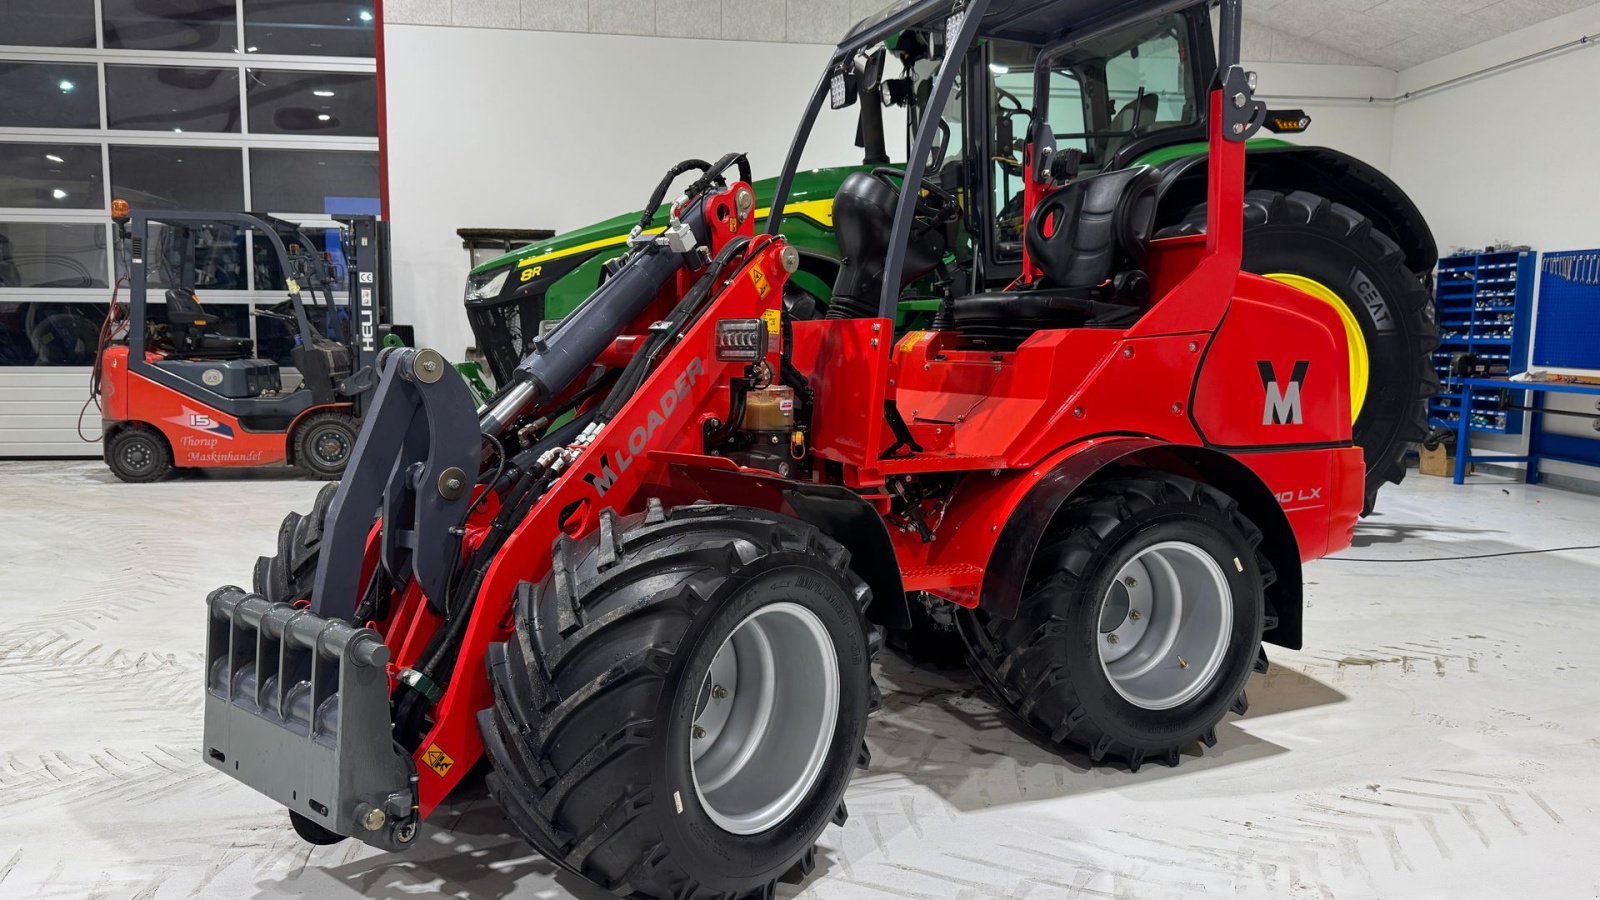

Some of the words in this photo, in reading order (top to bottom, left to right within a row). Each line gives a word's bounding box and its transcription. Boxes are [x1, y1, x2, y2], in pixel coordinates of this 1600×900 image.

[520, 266, 541, 281] 8R
[1358, 281, 1391, 322] CEAT
[361, 310, 374, 352] HELI
[190, 414, 210, 426] 15
[615, 357, 704, 473] LOADER
[180, 436, 217, 449] Thorup
[187, 451, 263, 463] Maskinhandel
[1298, 488, 1322, 500] LX
